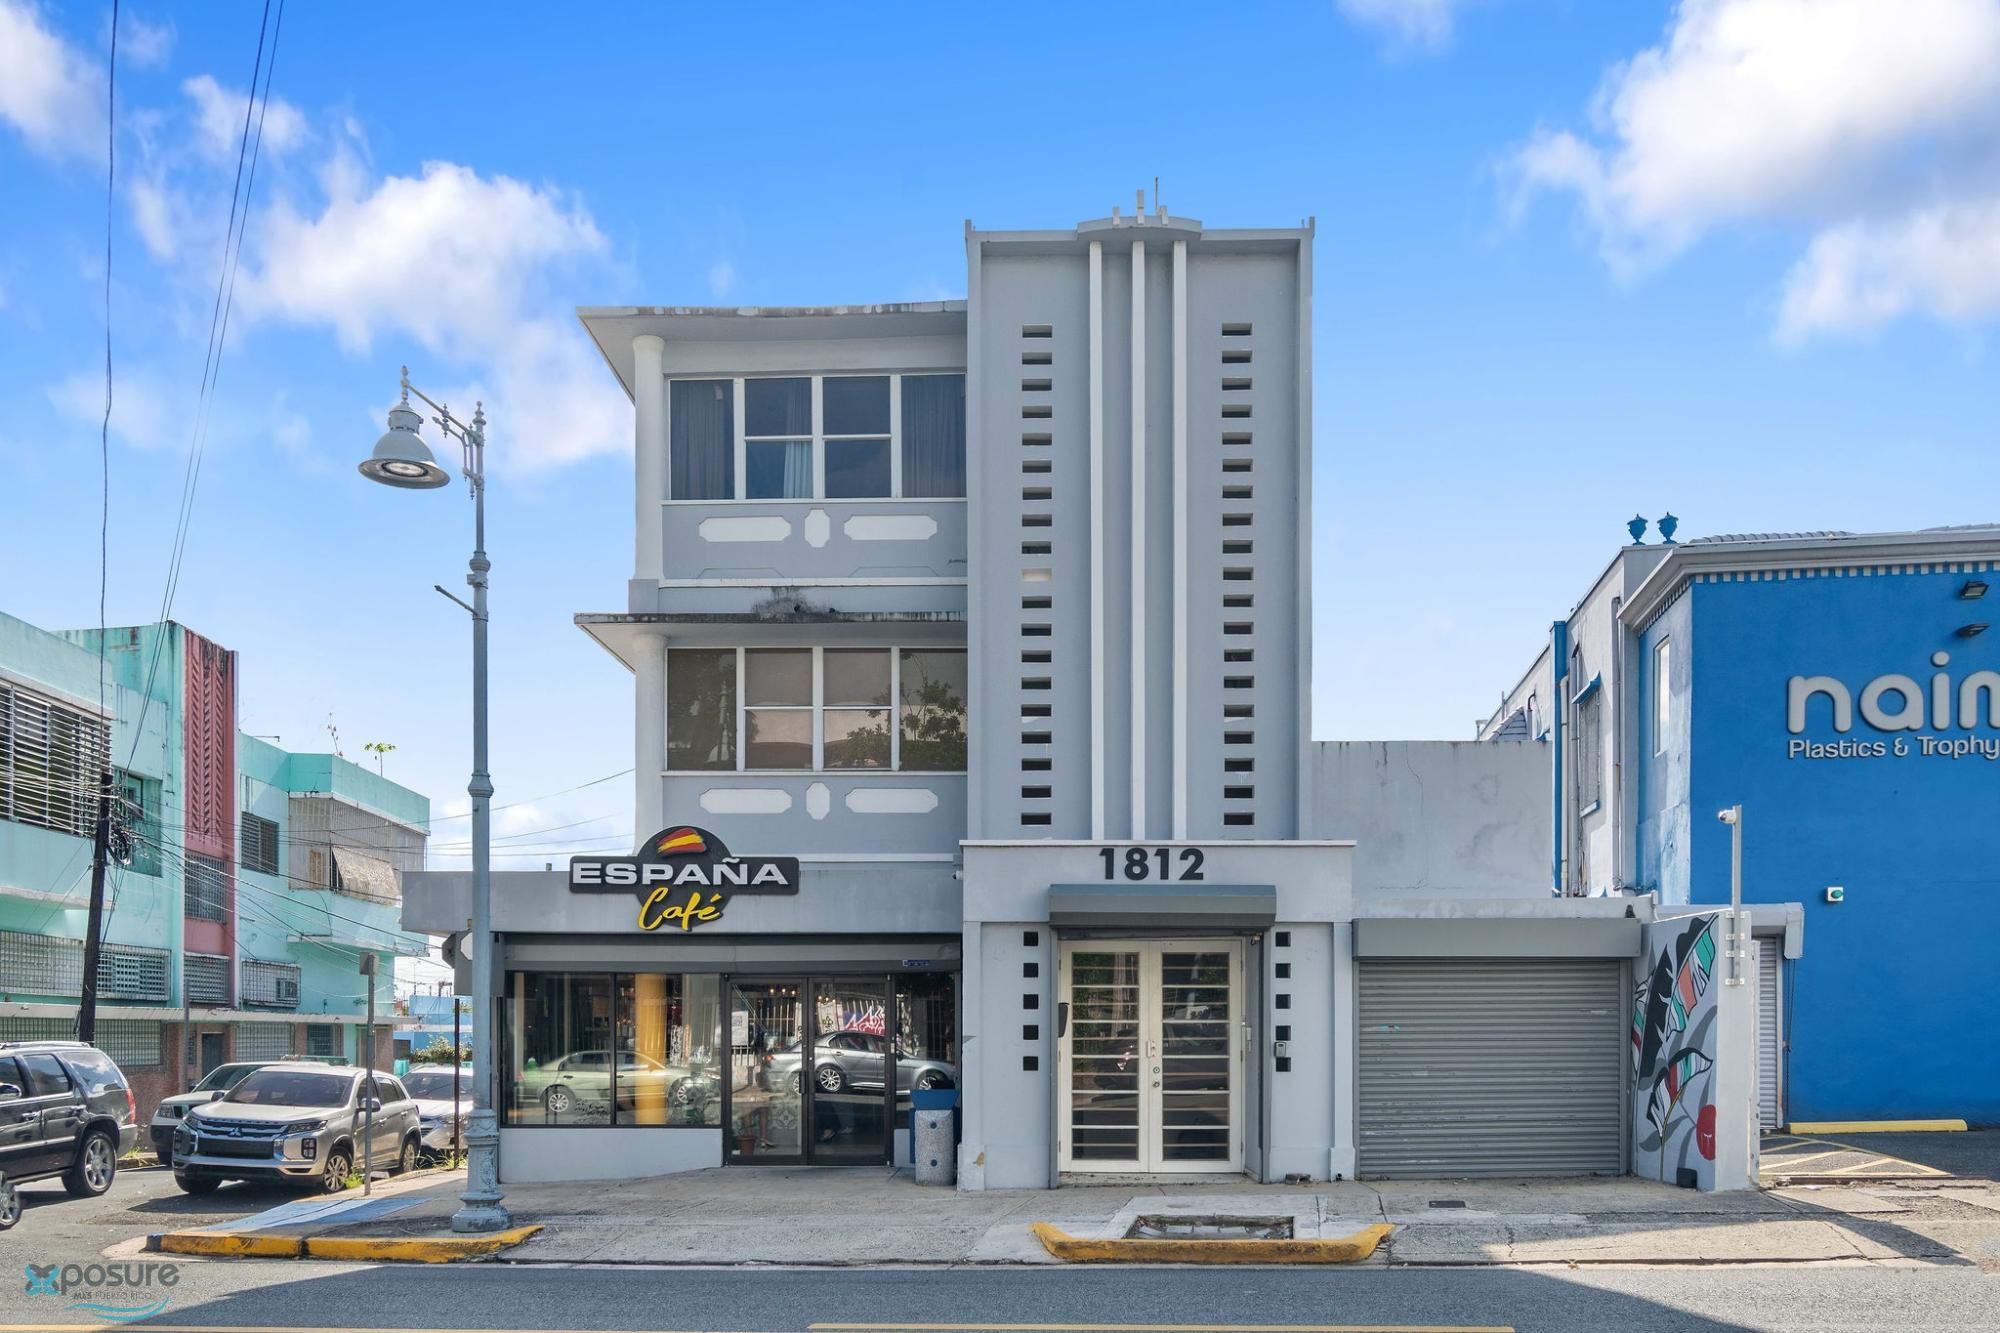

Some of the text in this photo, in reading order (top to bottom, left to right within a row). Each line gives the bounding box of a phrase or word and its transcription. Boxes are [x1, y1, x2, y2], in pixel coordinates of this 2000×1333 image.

[1789, 735, 2000, 760] Plastics & Trophy
[572, 857, 789, 886] ESPAÑA
[1099, 847, 1204, 881] 1812
[637, 886, 724, 932] Café
